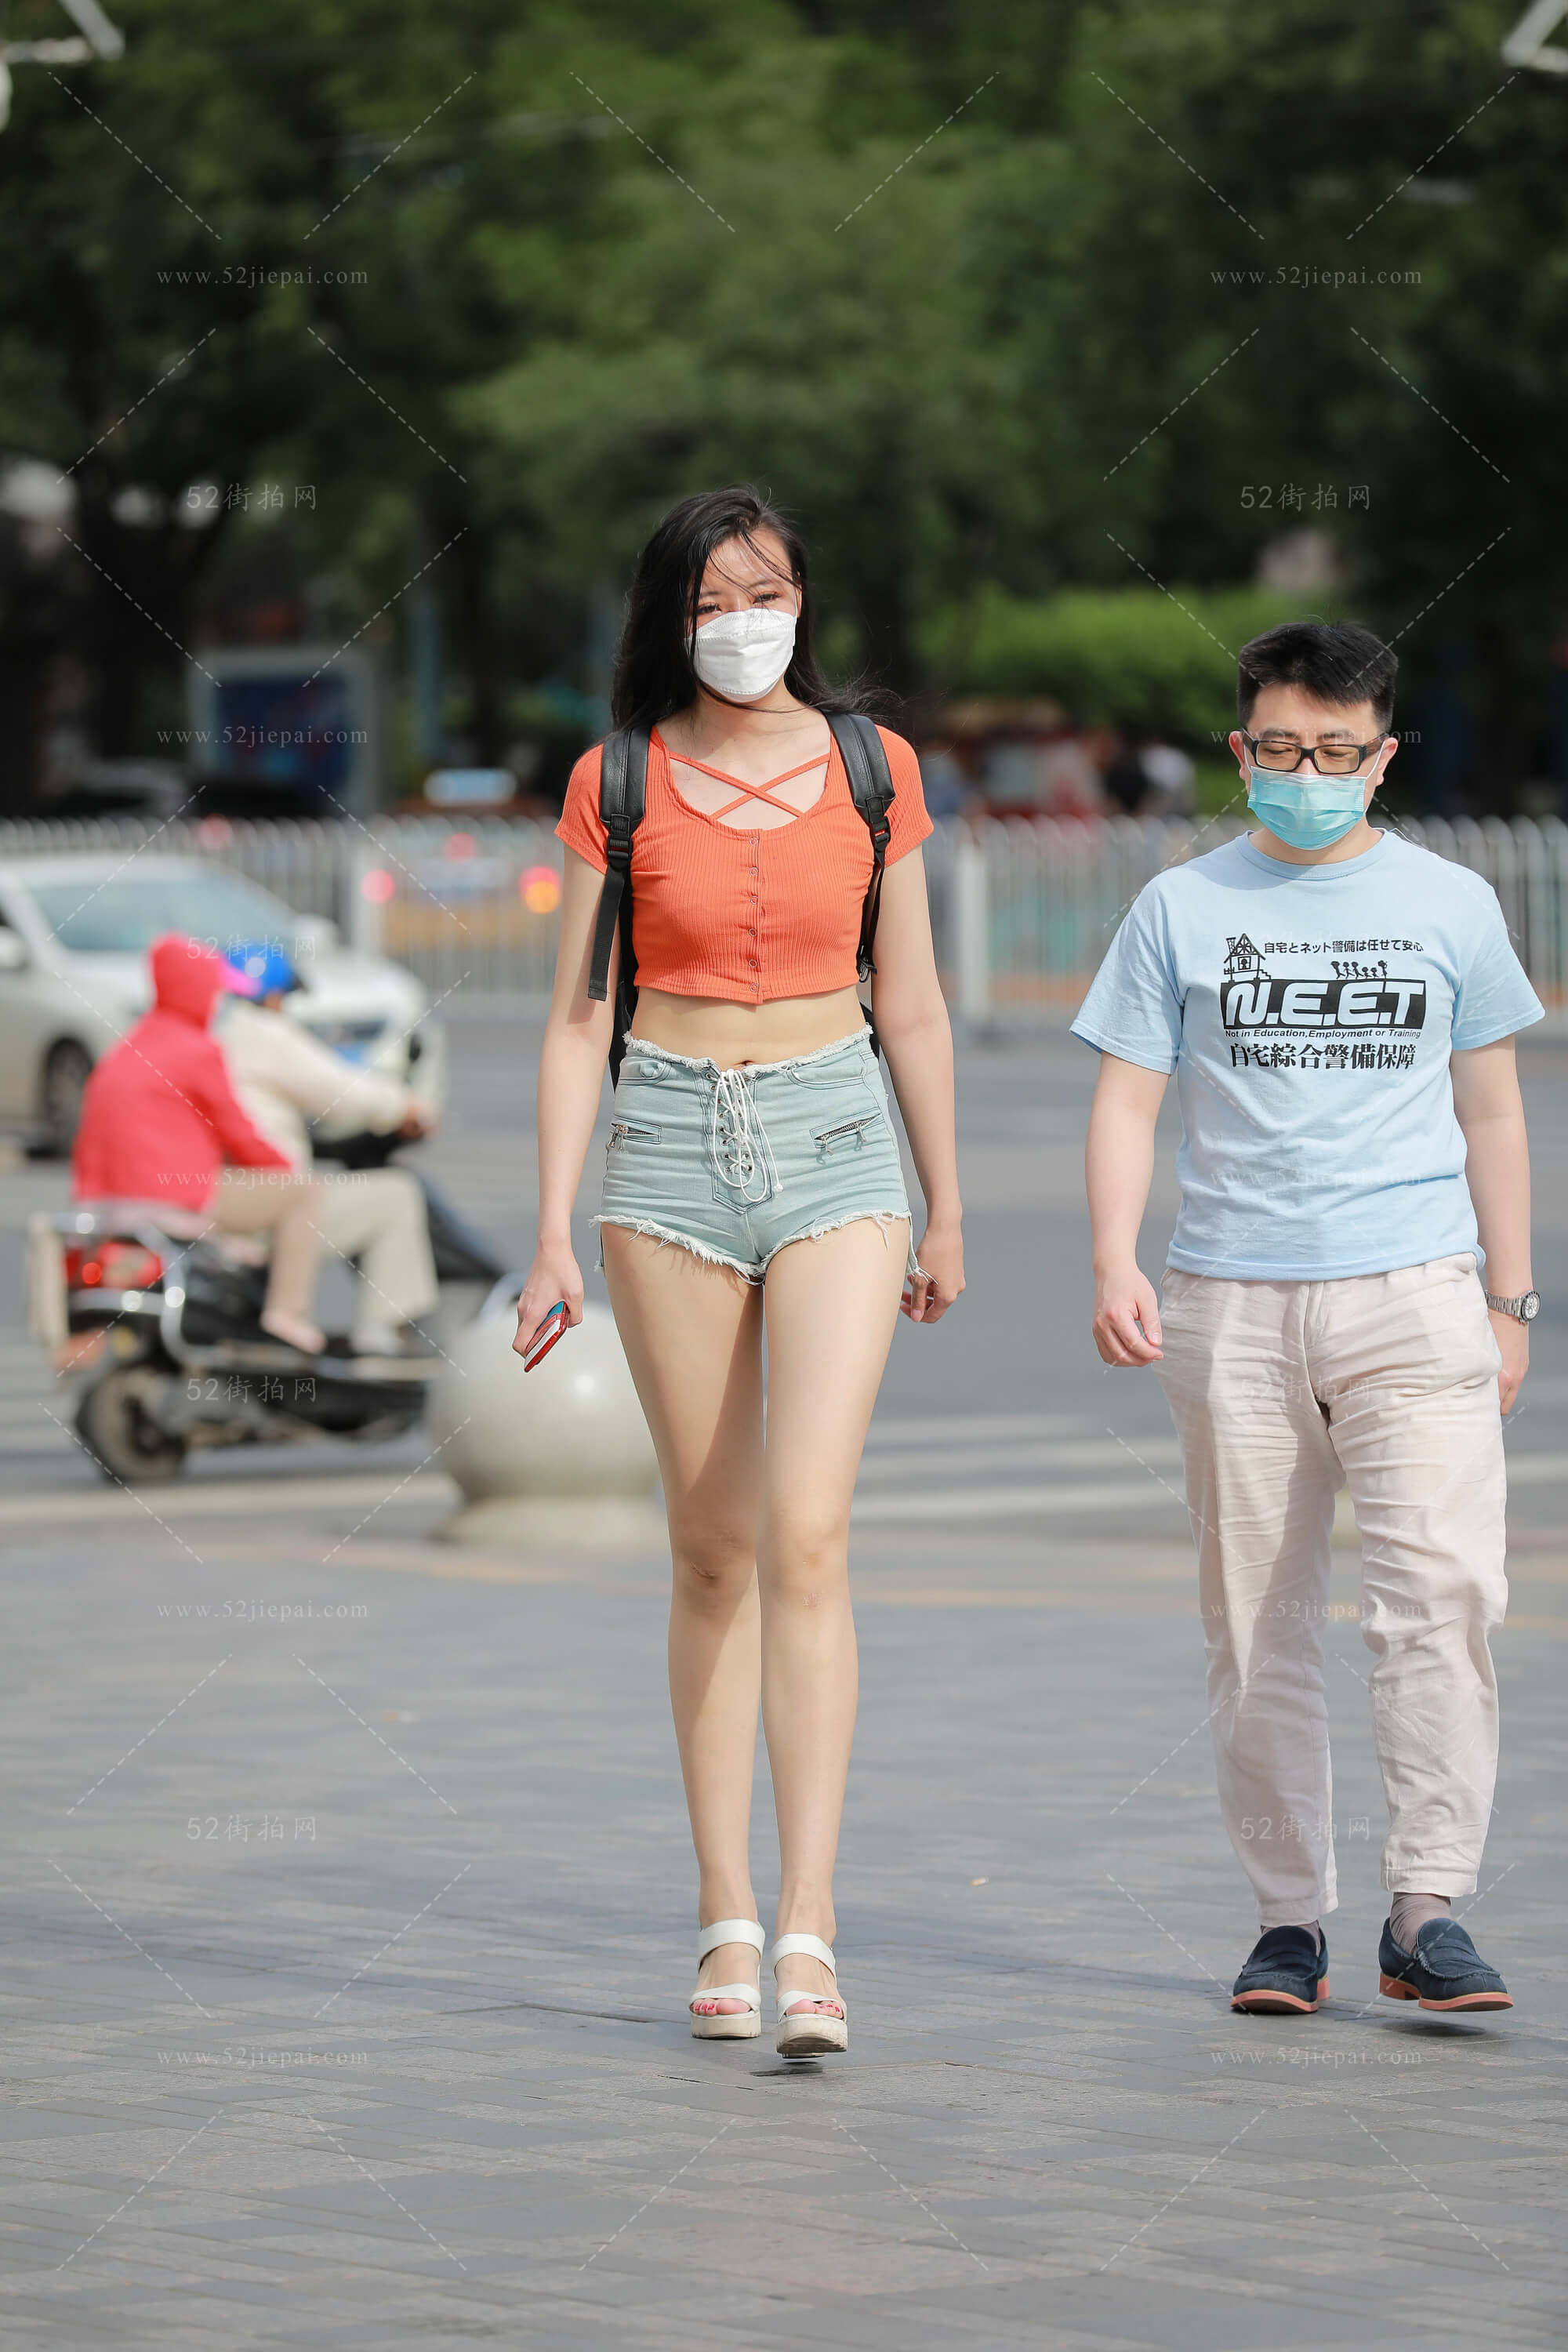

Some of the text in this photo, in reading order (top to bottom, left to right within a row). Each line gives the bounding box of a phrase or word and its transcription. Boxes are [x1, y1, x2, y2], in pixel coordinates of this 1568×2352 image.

[1264, 939, 1424, 954] 自宅とネット警備は任せて安心
[1225, 1029, 1239, 1038] Not
[1388, 1029, 1421, 1039] Training
